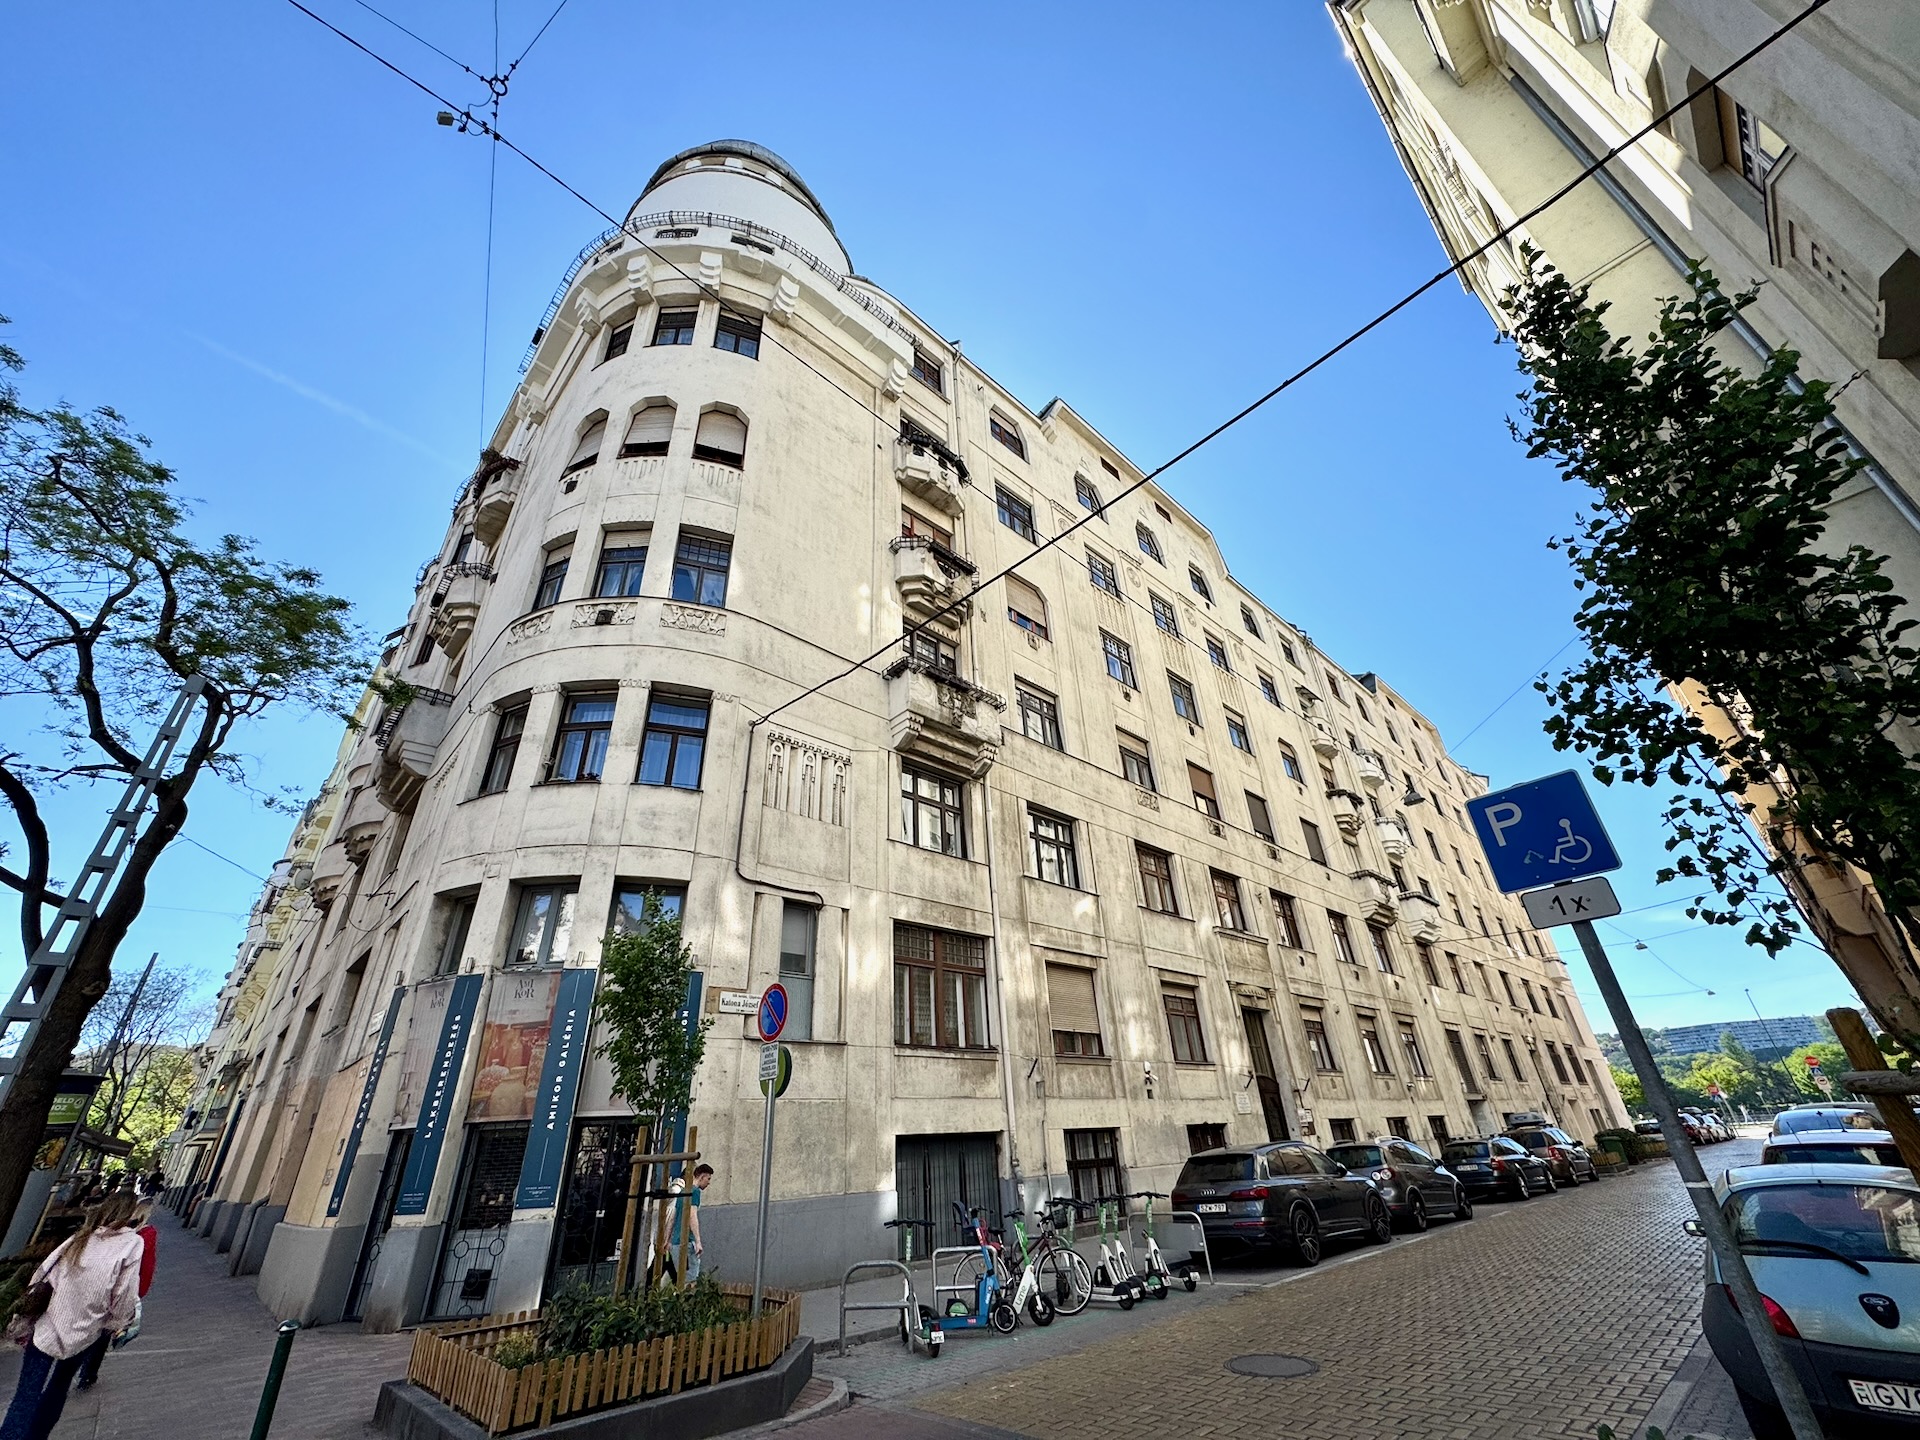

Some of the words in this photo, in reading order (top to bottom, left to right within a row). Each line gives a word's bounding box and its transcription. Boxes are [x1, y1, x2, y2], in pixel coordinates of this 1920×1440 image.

[1484, 802, 1522, 847] P
[721, 997, 741, 1007] Katona
[425, 1014, 461, 1138] LAKBERENDEZÉS
[547, 1075, 564, 1130] AMIKOR
[558, 1009, 576, 1068] GALÉRIA
[1015, 1284, 1027, 1306] Lime
[1858, 1393, 1871, 1403] H
